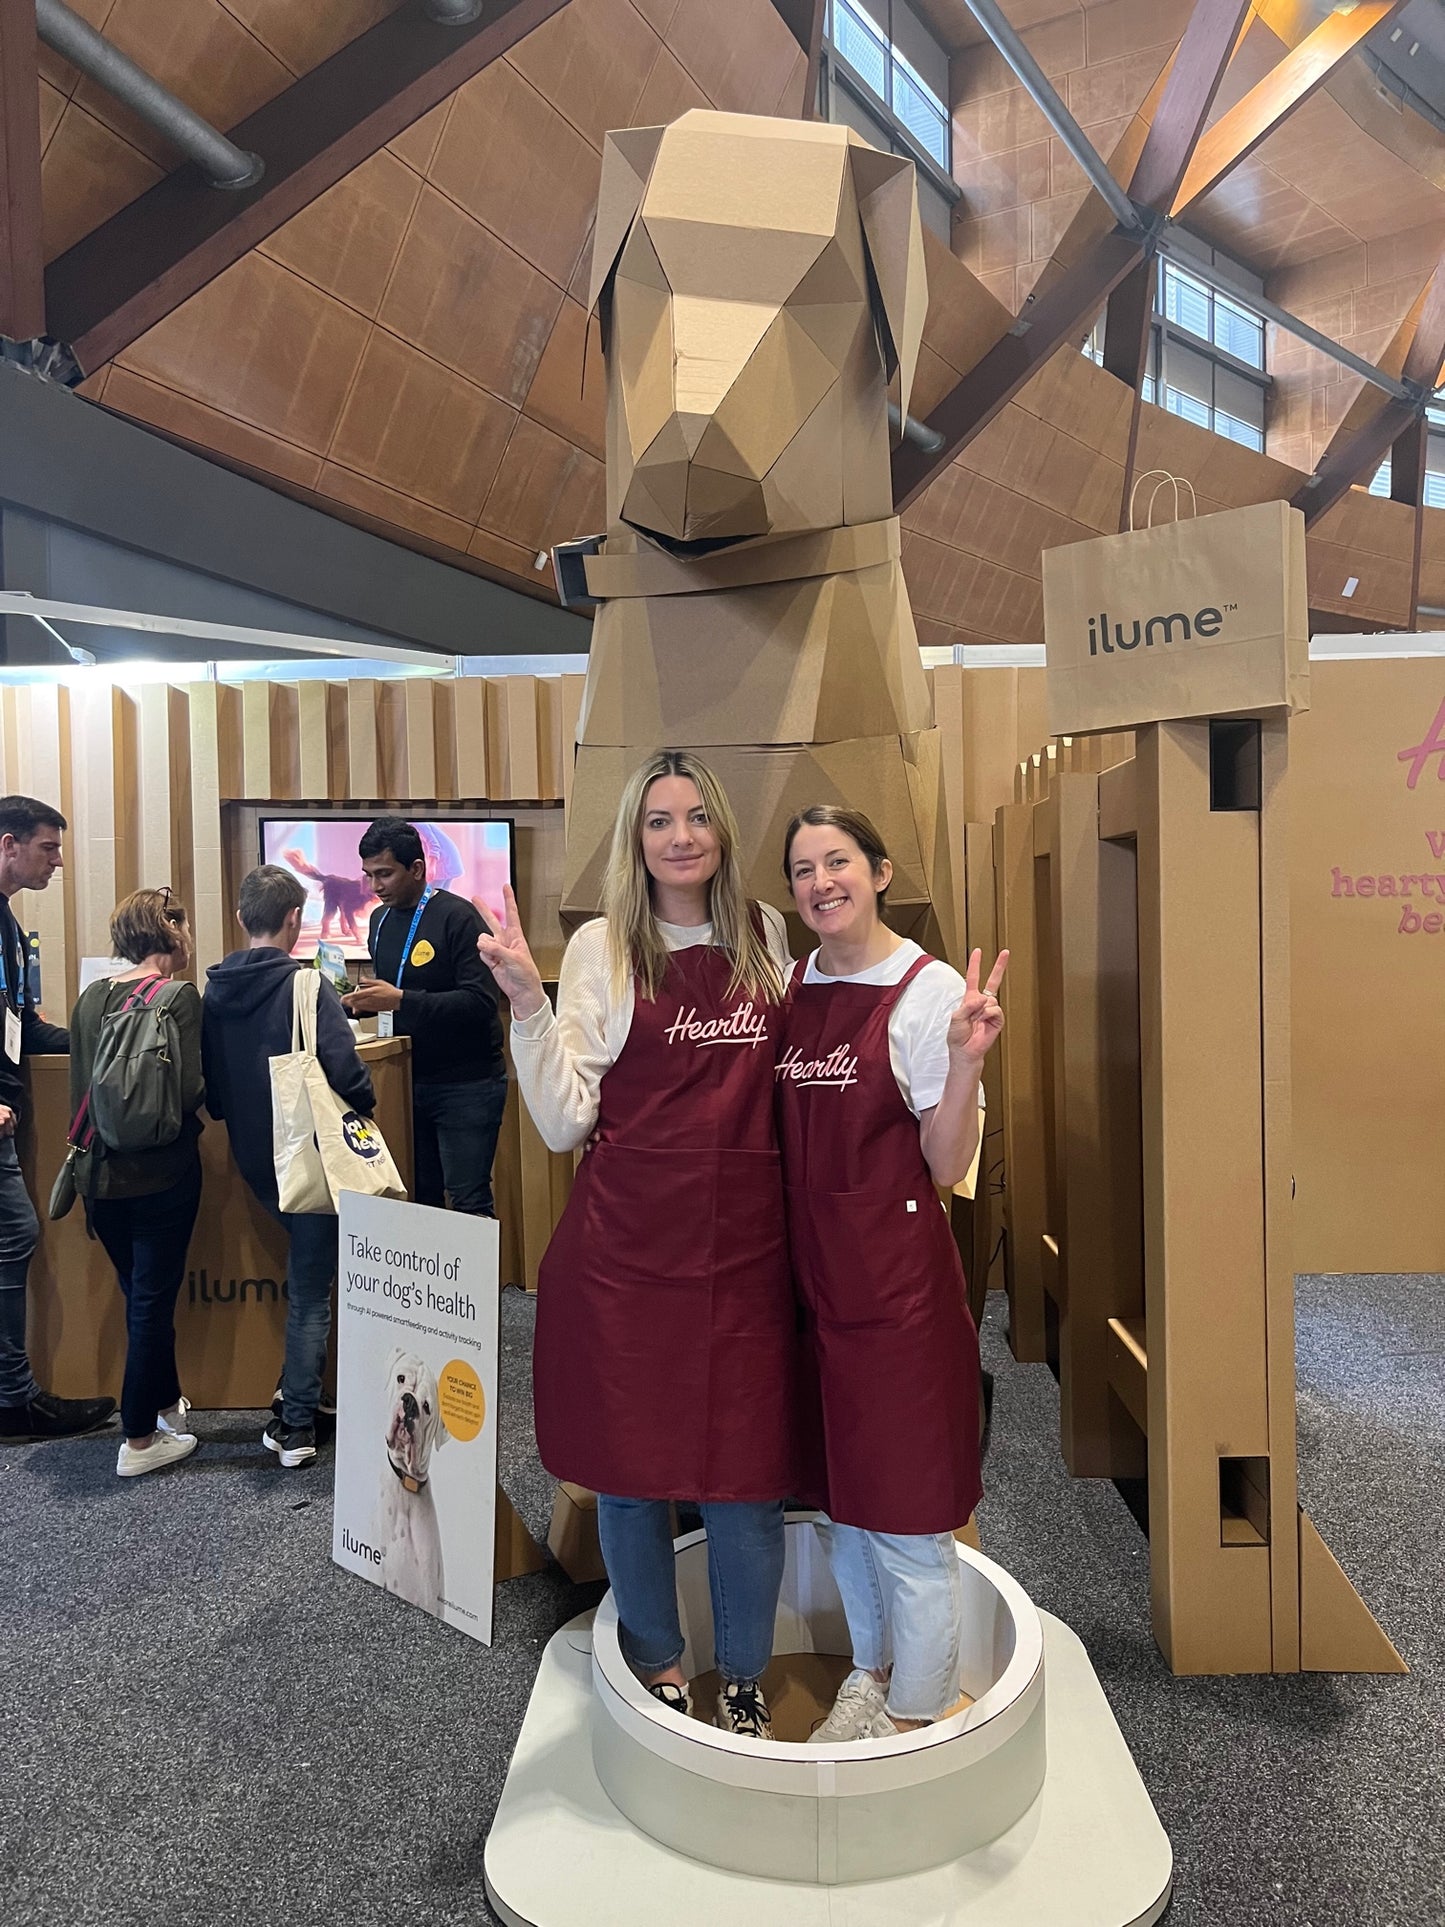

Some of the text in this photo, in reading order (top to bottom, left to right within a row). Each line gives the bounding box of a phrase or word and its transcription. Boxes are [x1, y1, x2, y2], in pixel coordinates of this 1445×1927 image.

[1088, 607, 1223, 656] ilume
[347, 1233, 462, 1281] Take control of
[188, 1269, 289, 1303] ilum
[346, 1271, 476, 1321] your dog's health
[372, 1310, 392, 1321] powered
[428, 1326, 438, 1335] and
[439, 1329, 458, 1343] activity
[459, 1335, 482, 1351] tracking
[342, 1528, 382, 1565] ilume
